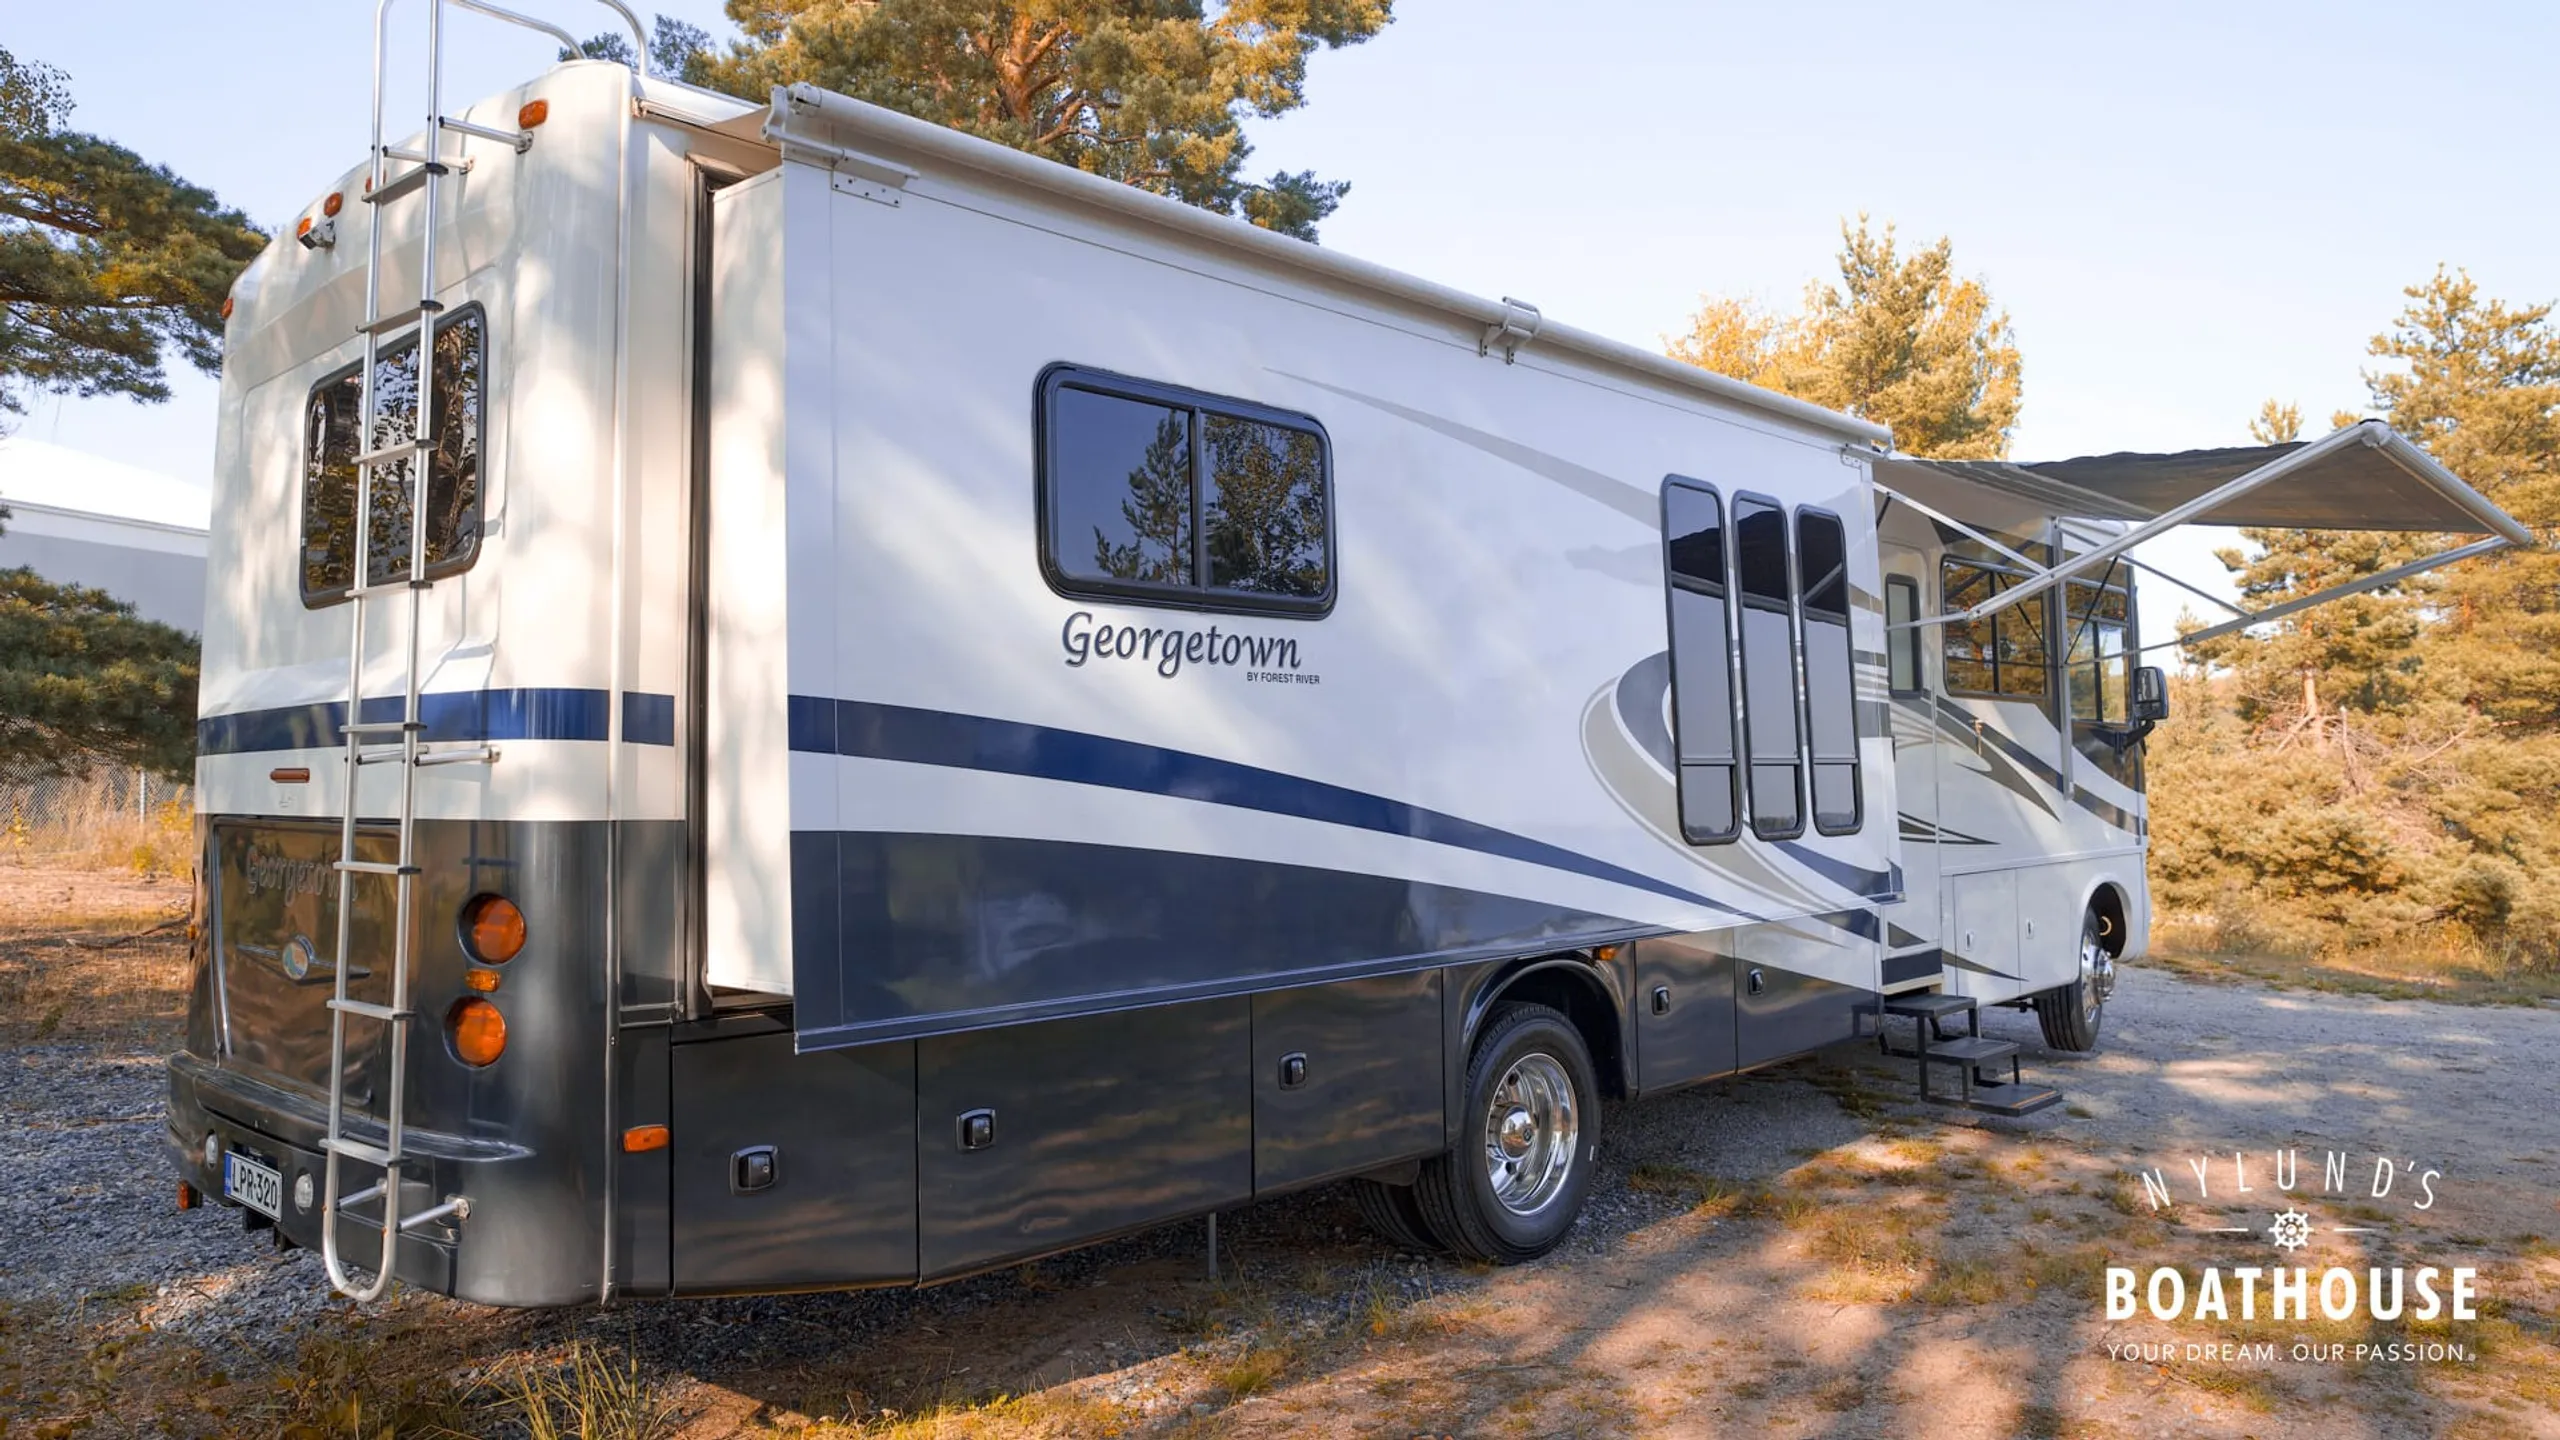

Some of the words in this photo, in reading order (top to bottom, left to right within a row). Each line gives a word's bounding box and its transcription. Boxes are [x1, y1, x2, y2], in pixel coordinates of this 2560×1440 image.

[1062, 611, 1301, 679] Georgetown
[1246, 671, 1259, 682] BY
[1261, 672, 1293, 684] FOREST
[1295, 674, 1320, 685] RIVER
[231, 1162, 278, 1211] LPR-320
